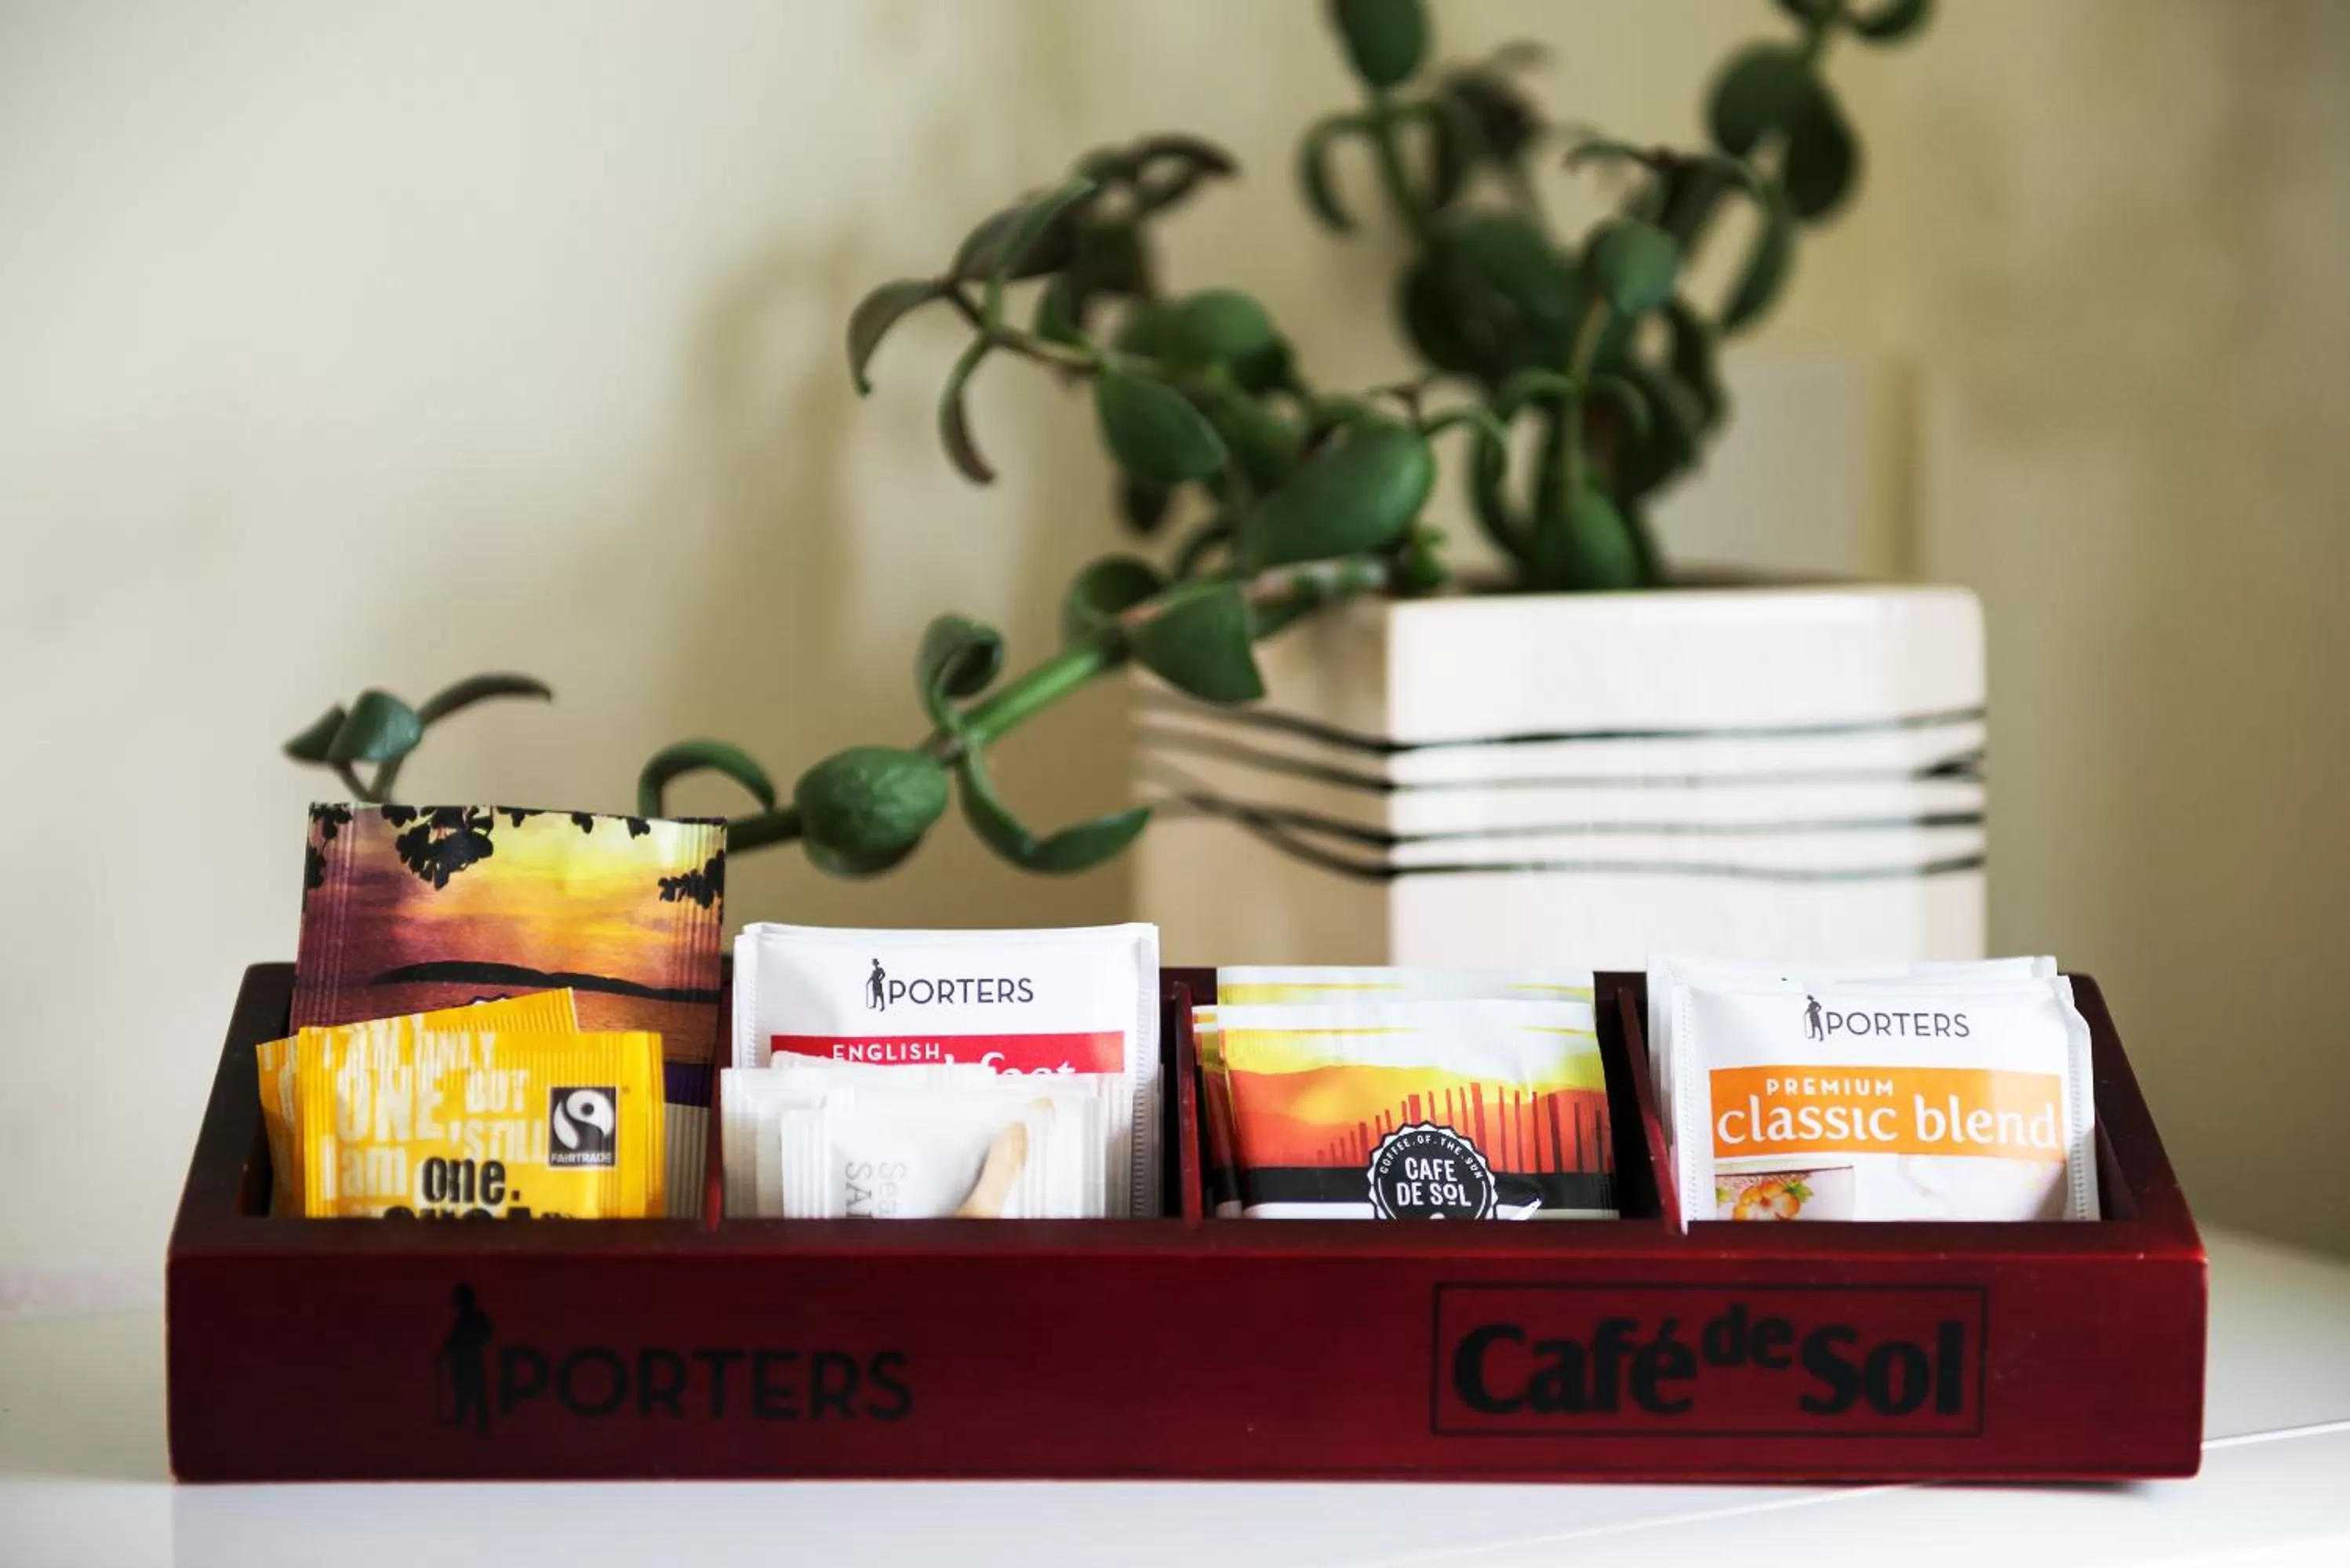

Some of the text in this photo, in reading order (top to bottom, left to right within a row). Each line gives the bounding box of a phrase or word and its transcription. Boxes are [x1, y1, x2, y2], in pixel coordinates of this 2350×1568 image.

[889, 977, 1034, 1005] PORTERS
[1825, 1011, 1970, 1038] PORTERS
[832, 1042, 940, 1061] ENGLISH
[1766, 1077, 1895, 1097] PREMIUM
[1716, 1093, 2059, 1151] classic blend
[463, 1118, 548, 1164] STILL
[1380, 1138, 1410, 1173] COFFEE
[1417, 1135, 1431, 1144] OF
[1441, 1138, 1463, 1155] THE
[551, 1152, 613, 1164] FAIRTRADE
[1404, 1156, 1458, 1182] CAFE
[340, 1146, 409, 1198] am
[420, 1155, 522, 1206] one.
[1395, 1181, 1425, 1207] DE
[1452, 1302, 1963, 1417] Café de Sol
[497, 1344, 914, 1423] PORTERS
